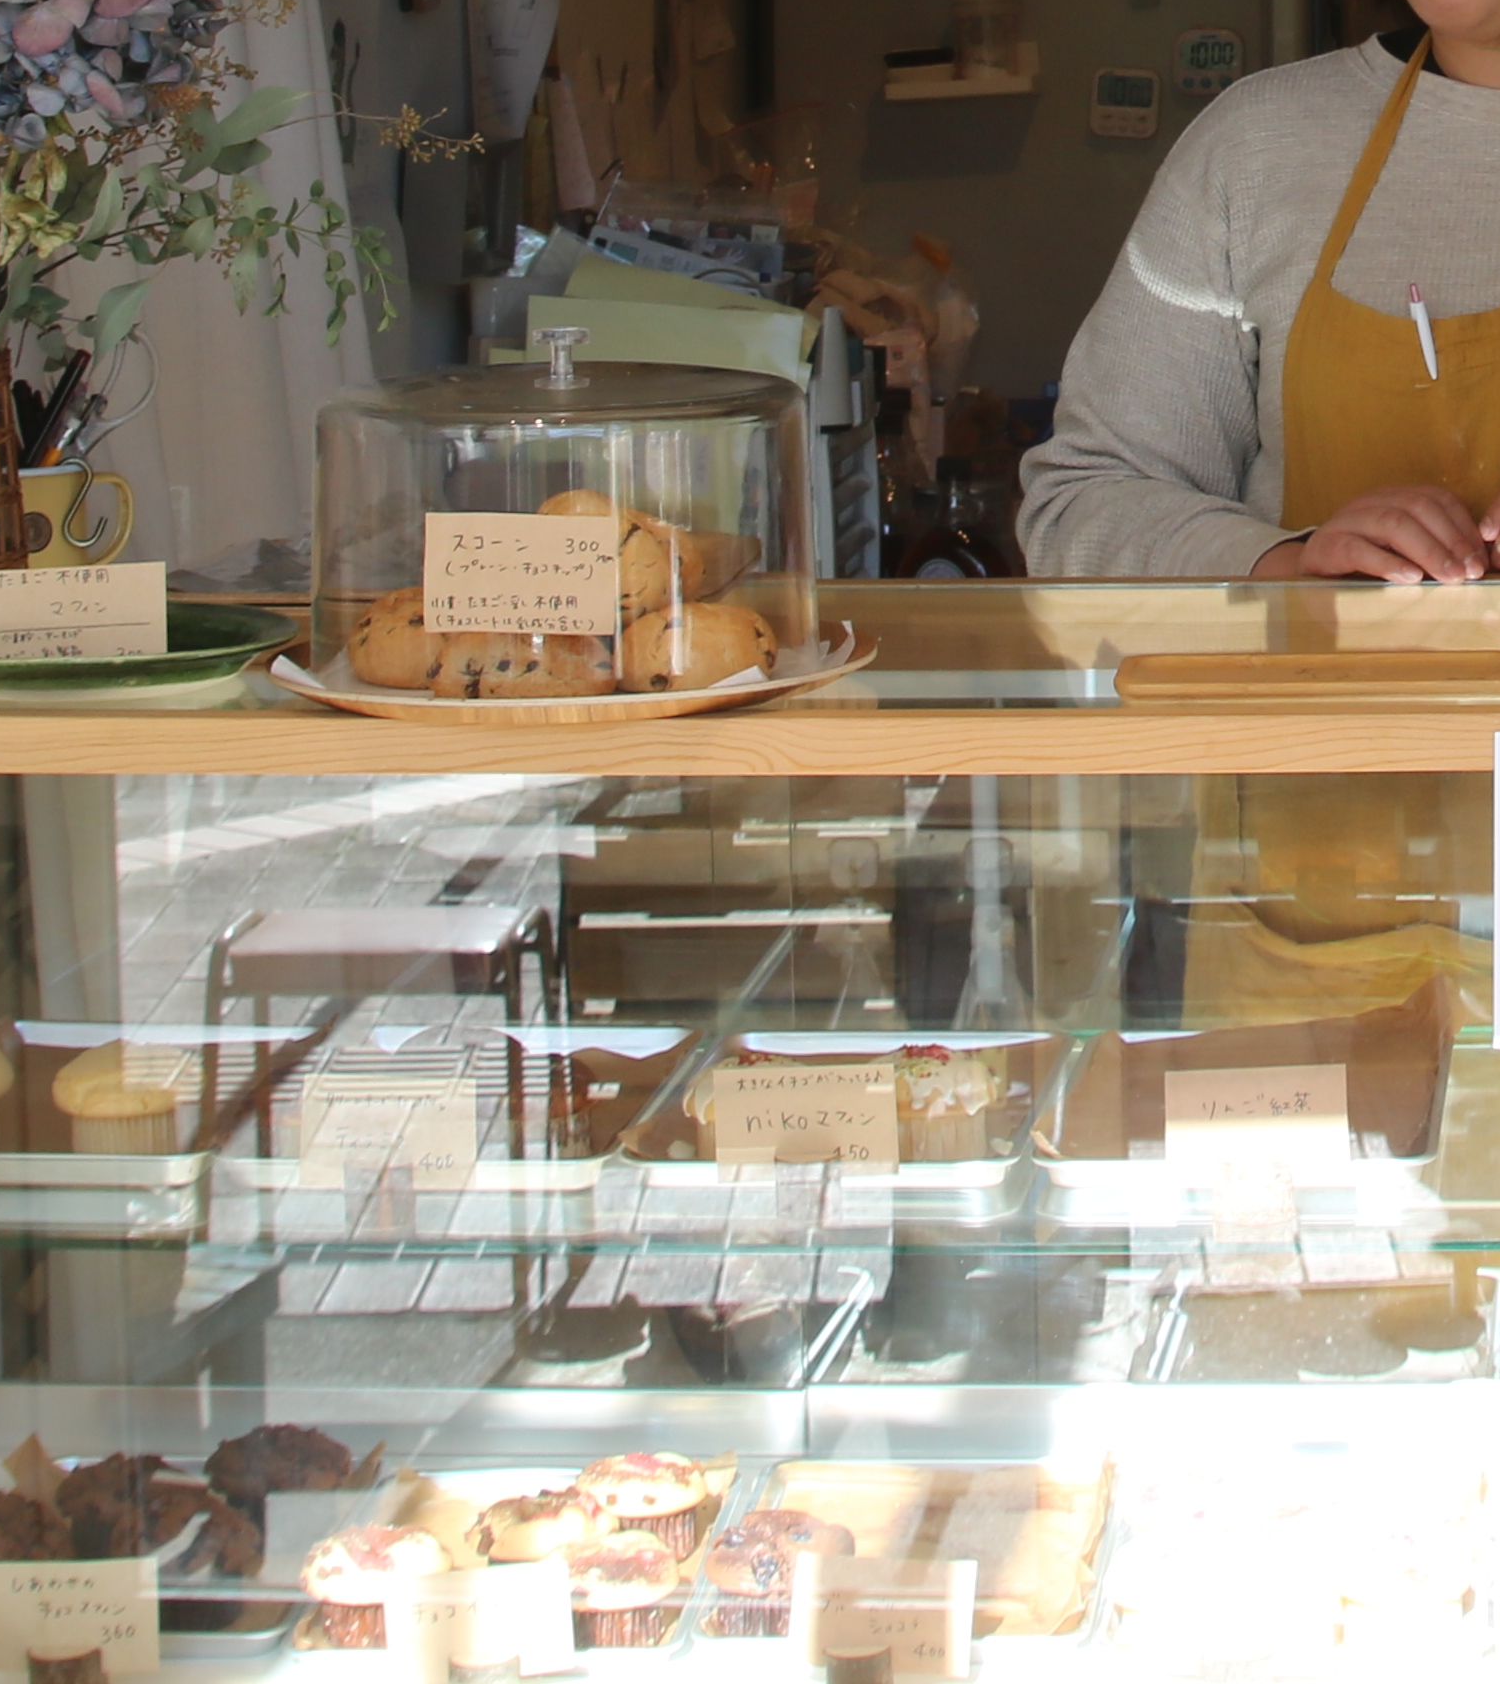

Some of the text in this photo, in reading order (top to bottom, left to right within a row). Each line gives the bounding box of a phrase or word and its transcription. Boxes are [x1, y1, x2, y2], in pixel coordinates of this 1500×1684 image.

[452, 534, 530, 552] スコーン
[565, 538, 600, 555] 300
[50, 600, 107, 615] マフィン
[746, 1110, 876, 1134] nikoマフィン
[101, 1623, 136, 1644] 360
[913, 1642, 946, 1659] 400
